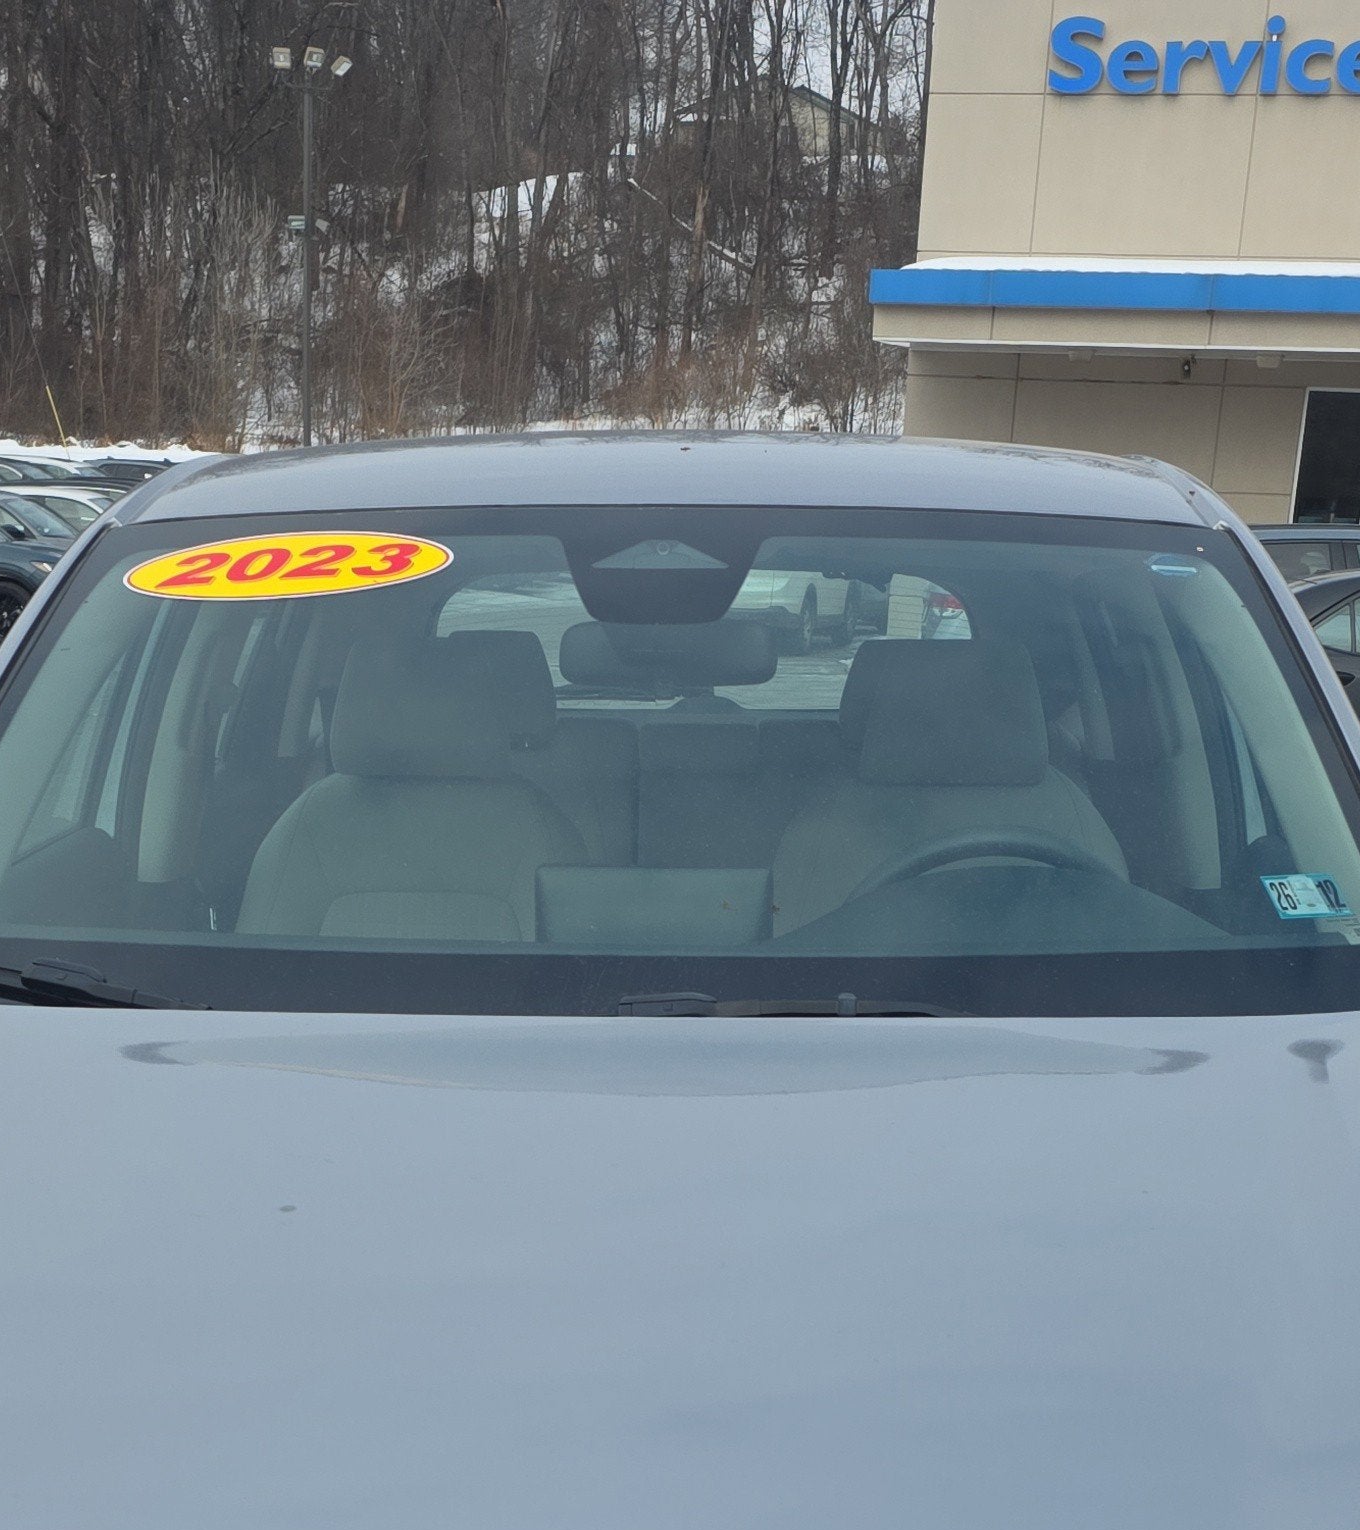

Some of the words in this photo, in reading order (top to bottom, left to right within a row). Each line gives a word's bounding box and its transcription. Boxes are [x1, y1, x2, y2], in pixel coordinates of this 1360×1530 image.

[154, 543, 423, 589] 2023
[1269, 881, 1298, 911] 26
[1315, 879, 1347, 912] 12
